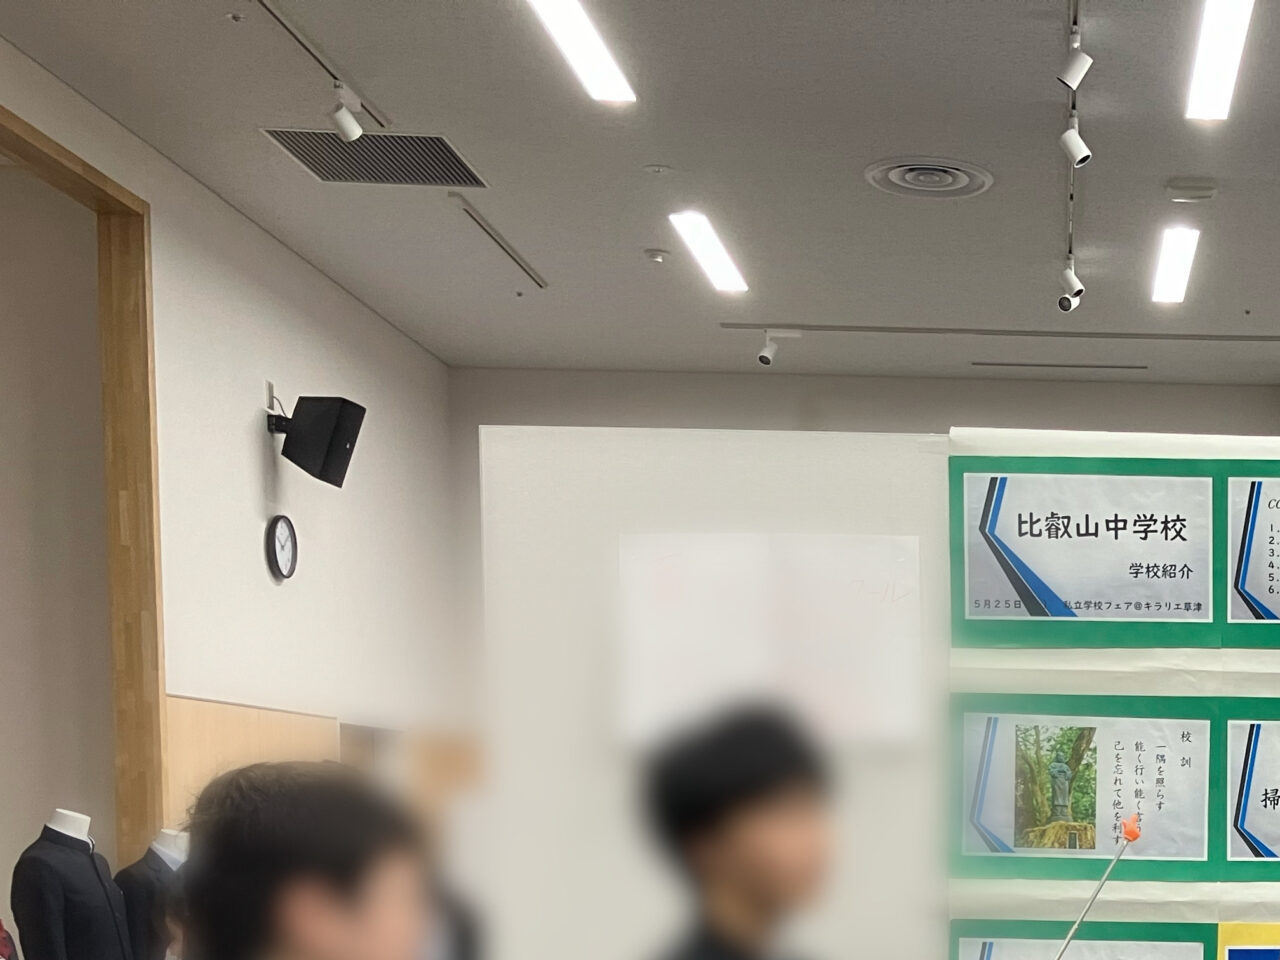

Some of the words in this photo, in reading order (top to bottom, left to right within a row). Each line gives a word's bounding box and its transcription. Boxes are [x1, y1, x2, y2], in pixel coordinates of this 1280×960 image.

[1017, 511, 1188, 542] 比叡山中学校
[1129, 562, 1193, 580] 学校紹介
